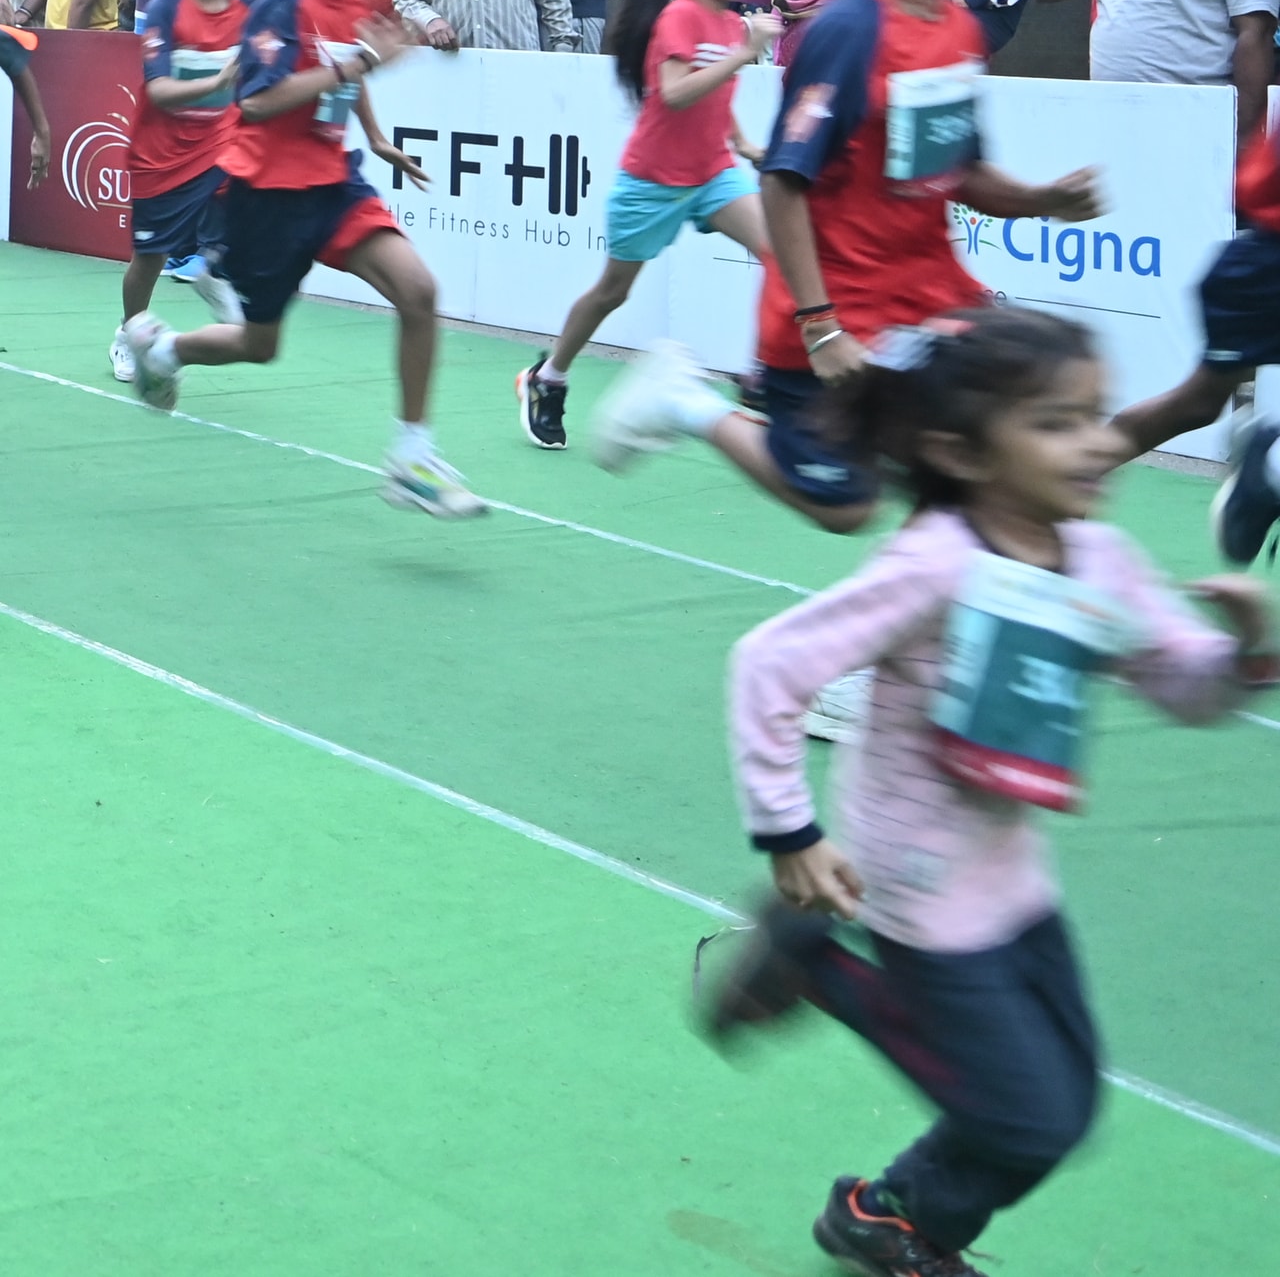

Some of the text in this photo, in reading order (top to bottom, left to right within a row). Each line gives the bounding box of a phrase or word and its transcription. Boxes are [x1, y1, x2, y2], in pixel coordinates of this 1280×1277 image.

[98, 167, 131, 202] SU
[429, 207, 509, 239] Fitness
[525, 219, 570, 246] Hub
[1002, 216, 1161, 283] Cigna
